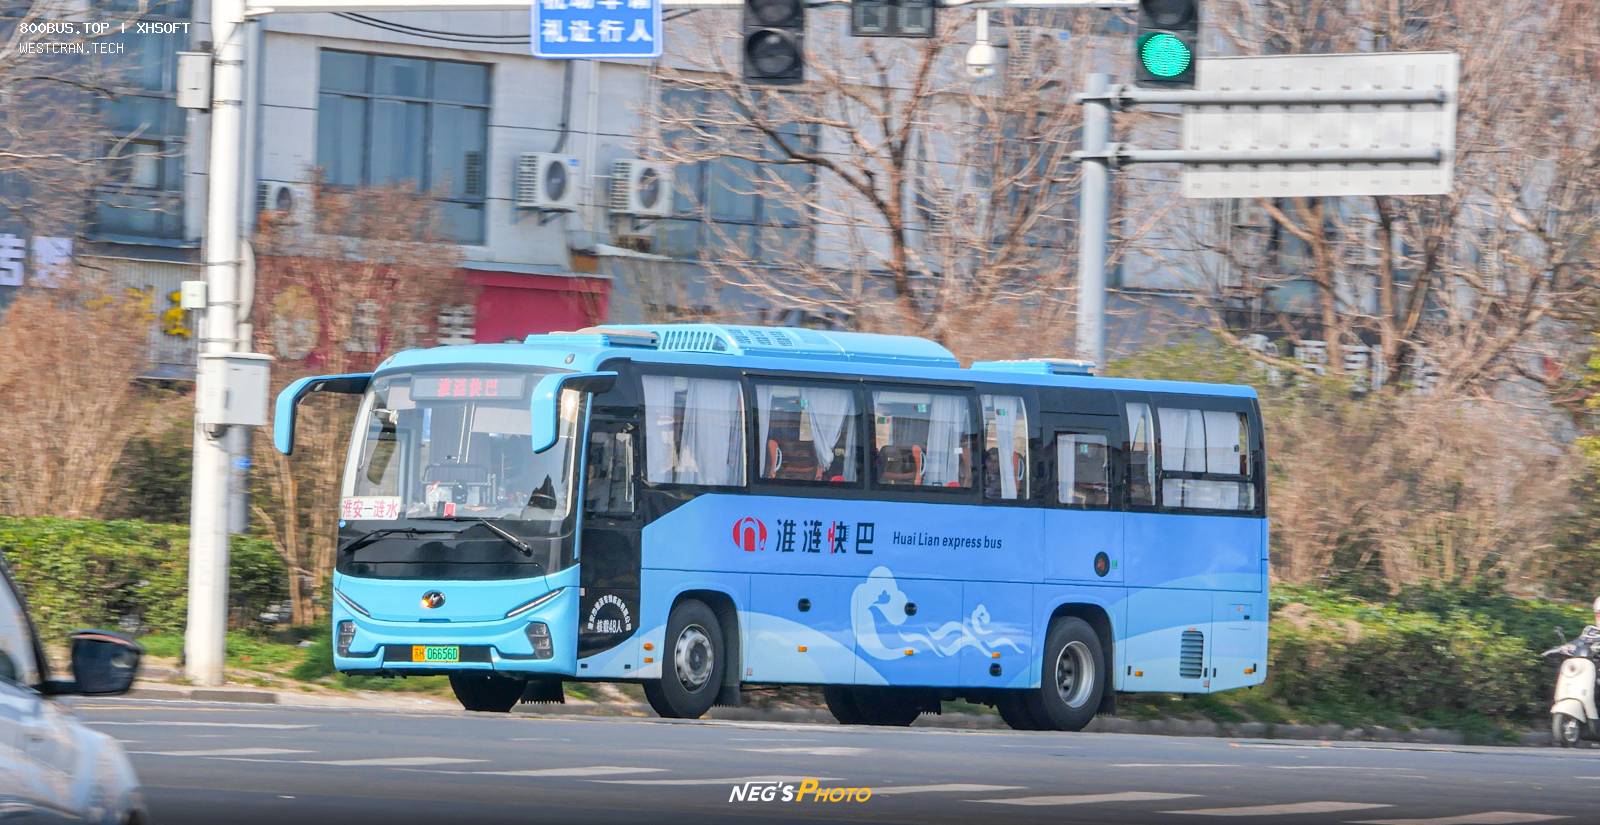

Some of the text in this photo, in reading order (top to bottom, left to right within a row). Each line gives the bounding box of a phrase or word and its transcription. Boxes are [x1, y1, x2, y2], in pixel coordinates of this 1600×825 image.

[541, 18, 653, 43] 礼让行人
[775, 518, 875, 555] 淮涟快巴
[892, 531, 1002, 550] Huai Lian express bus
